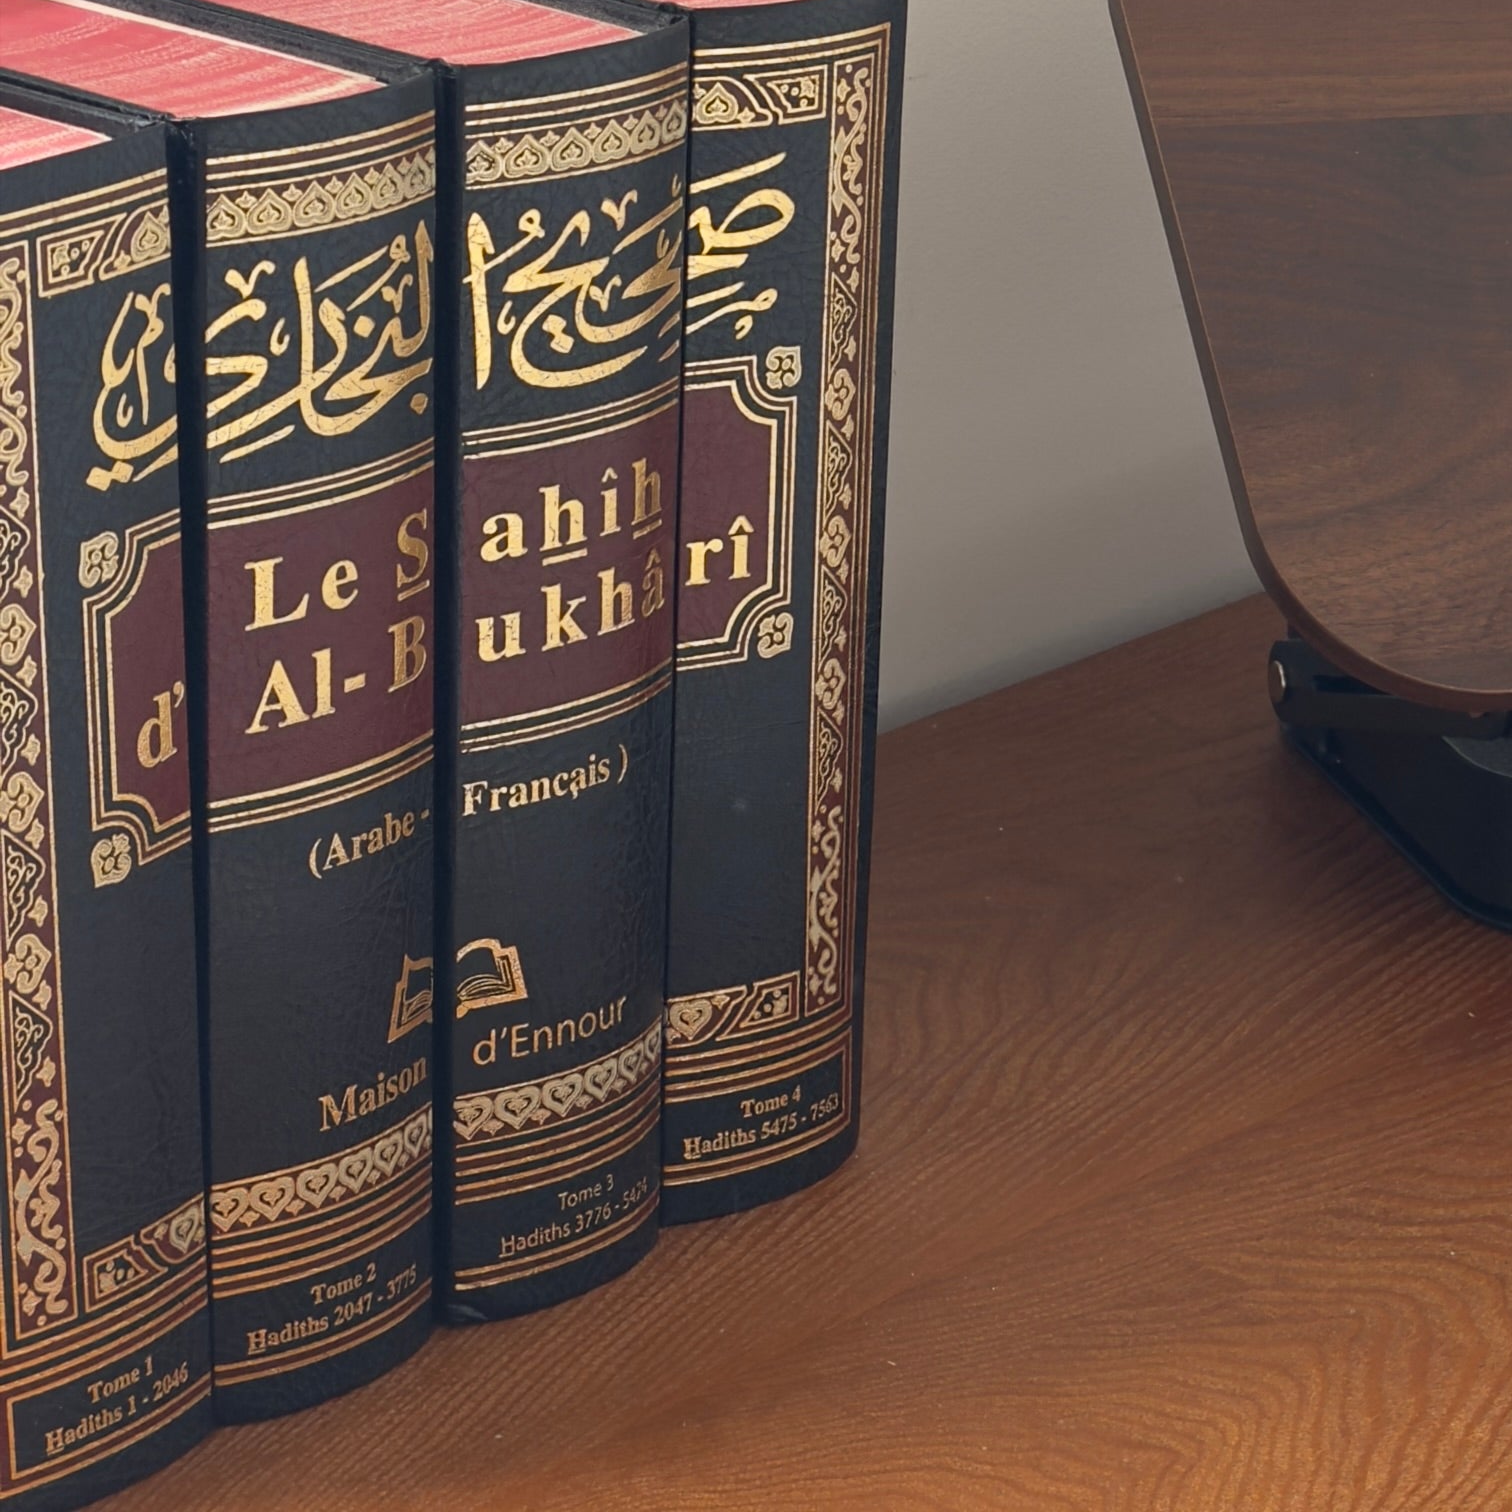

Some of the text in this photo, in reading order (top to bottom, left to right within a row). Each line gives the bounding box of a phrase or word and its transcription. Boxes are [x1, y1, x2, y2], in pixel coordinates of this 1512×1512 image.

[244, 555, 360, 632] Le
[472, 995, 627, 1066] d'Ennour
[318, 1056, 428, 1132] Maison
[682, 1127, 758, 1161] Hadiths
[760, 1111, 798, 1141] 5475
[810, 1091, 840, 1122] 7563
[739, 1084, 802, 1119] Tome 4
[557, 1173, 615, 1211] Tome 3
[498, 1221, 572, 1259] Hadiths
[574, 1201, 613, 1234] 3776
[246, 1314, 330, 1356] Hadiths
[333, 1291, 374, 1327] 2047
[386, 1262, 418, 1300] 3775
[310, 1261, 377, 1306] Tome 2
[44, 1405, 123, 1457] Hadiths
[127, 1394, 138, 1417] 1
[151, 1360, 190, 1403] 2046
[87, 1353, 154, 1405] Tome 1
